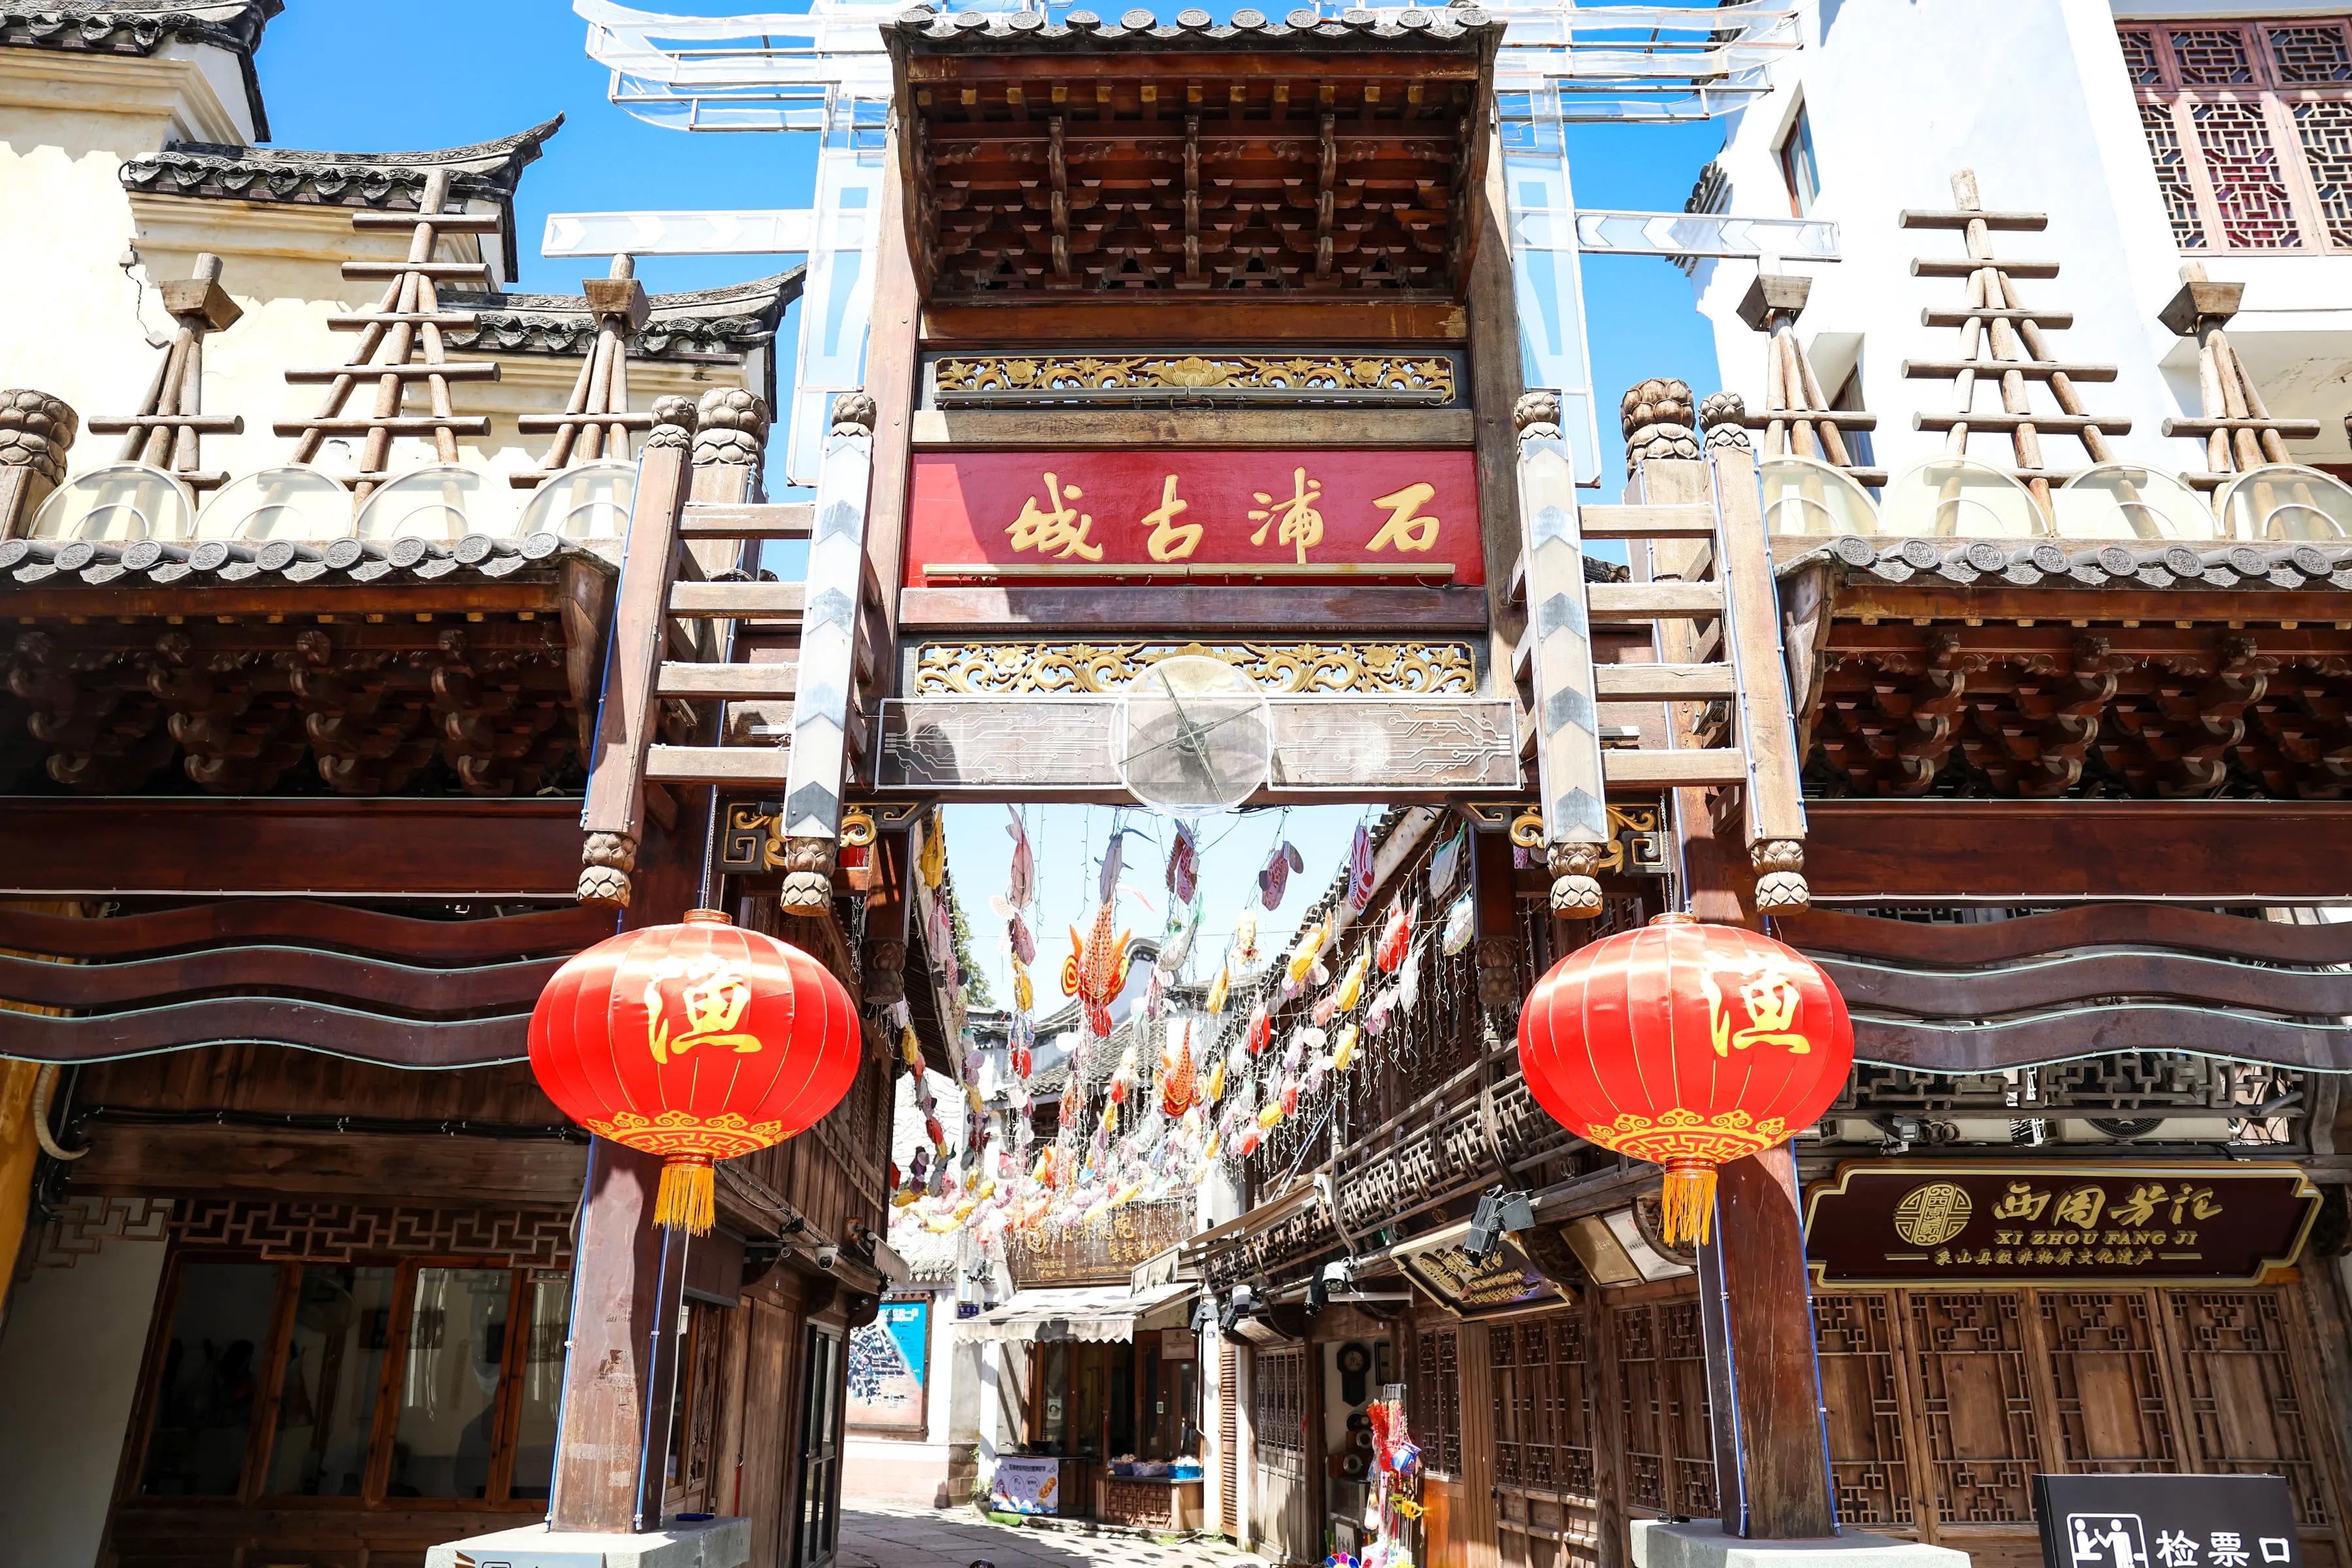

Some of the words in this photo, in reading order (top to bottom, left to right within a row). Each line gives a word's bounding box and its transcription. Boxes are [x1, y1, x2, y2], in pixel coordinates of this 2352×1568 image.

[1004, 466, 1441, 564] 石浦古城
[1991, 1181, 2223, 1230] 西周芳记
[1935, 1247, 2153, 1266] 象山县级非物质文化遗产
[1995, 1230, 2024, 1245] XI
[2031, 1230, 2099, 1245] ZHOU
[2104, 1230, 2167, 1245] FANG
[2172, 1230, 2198, 1245] JI
[2156, 1529, 2291, 1568] 检票口
